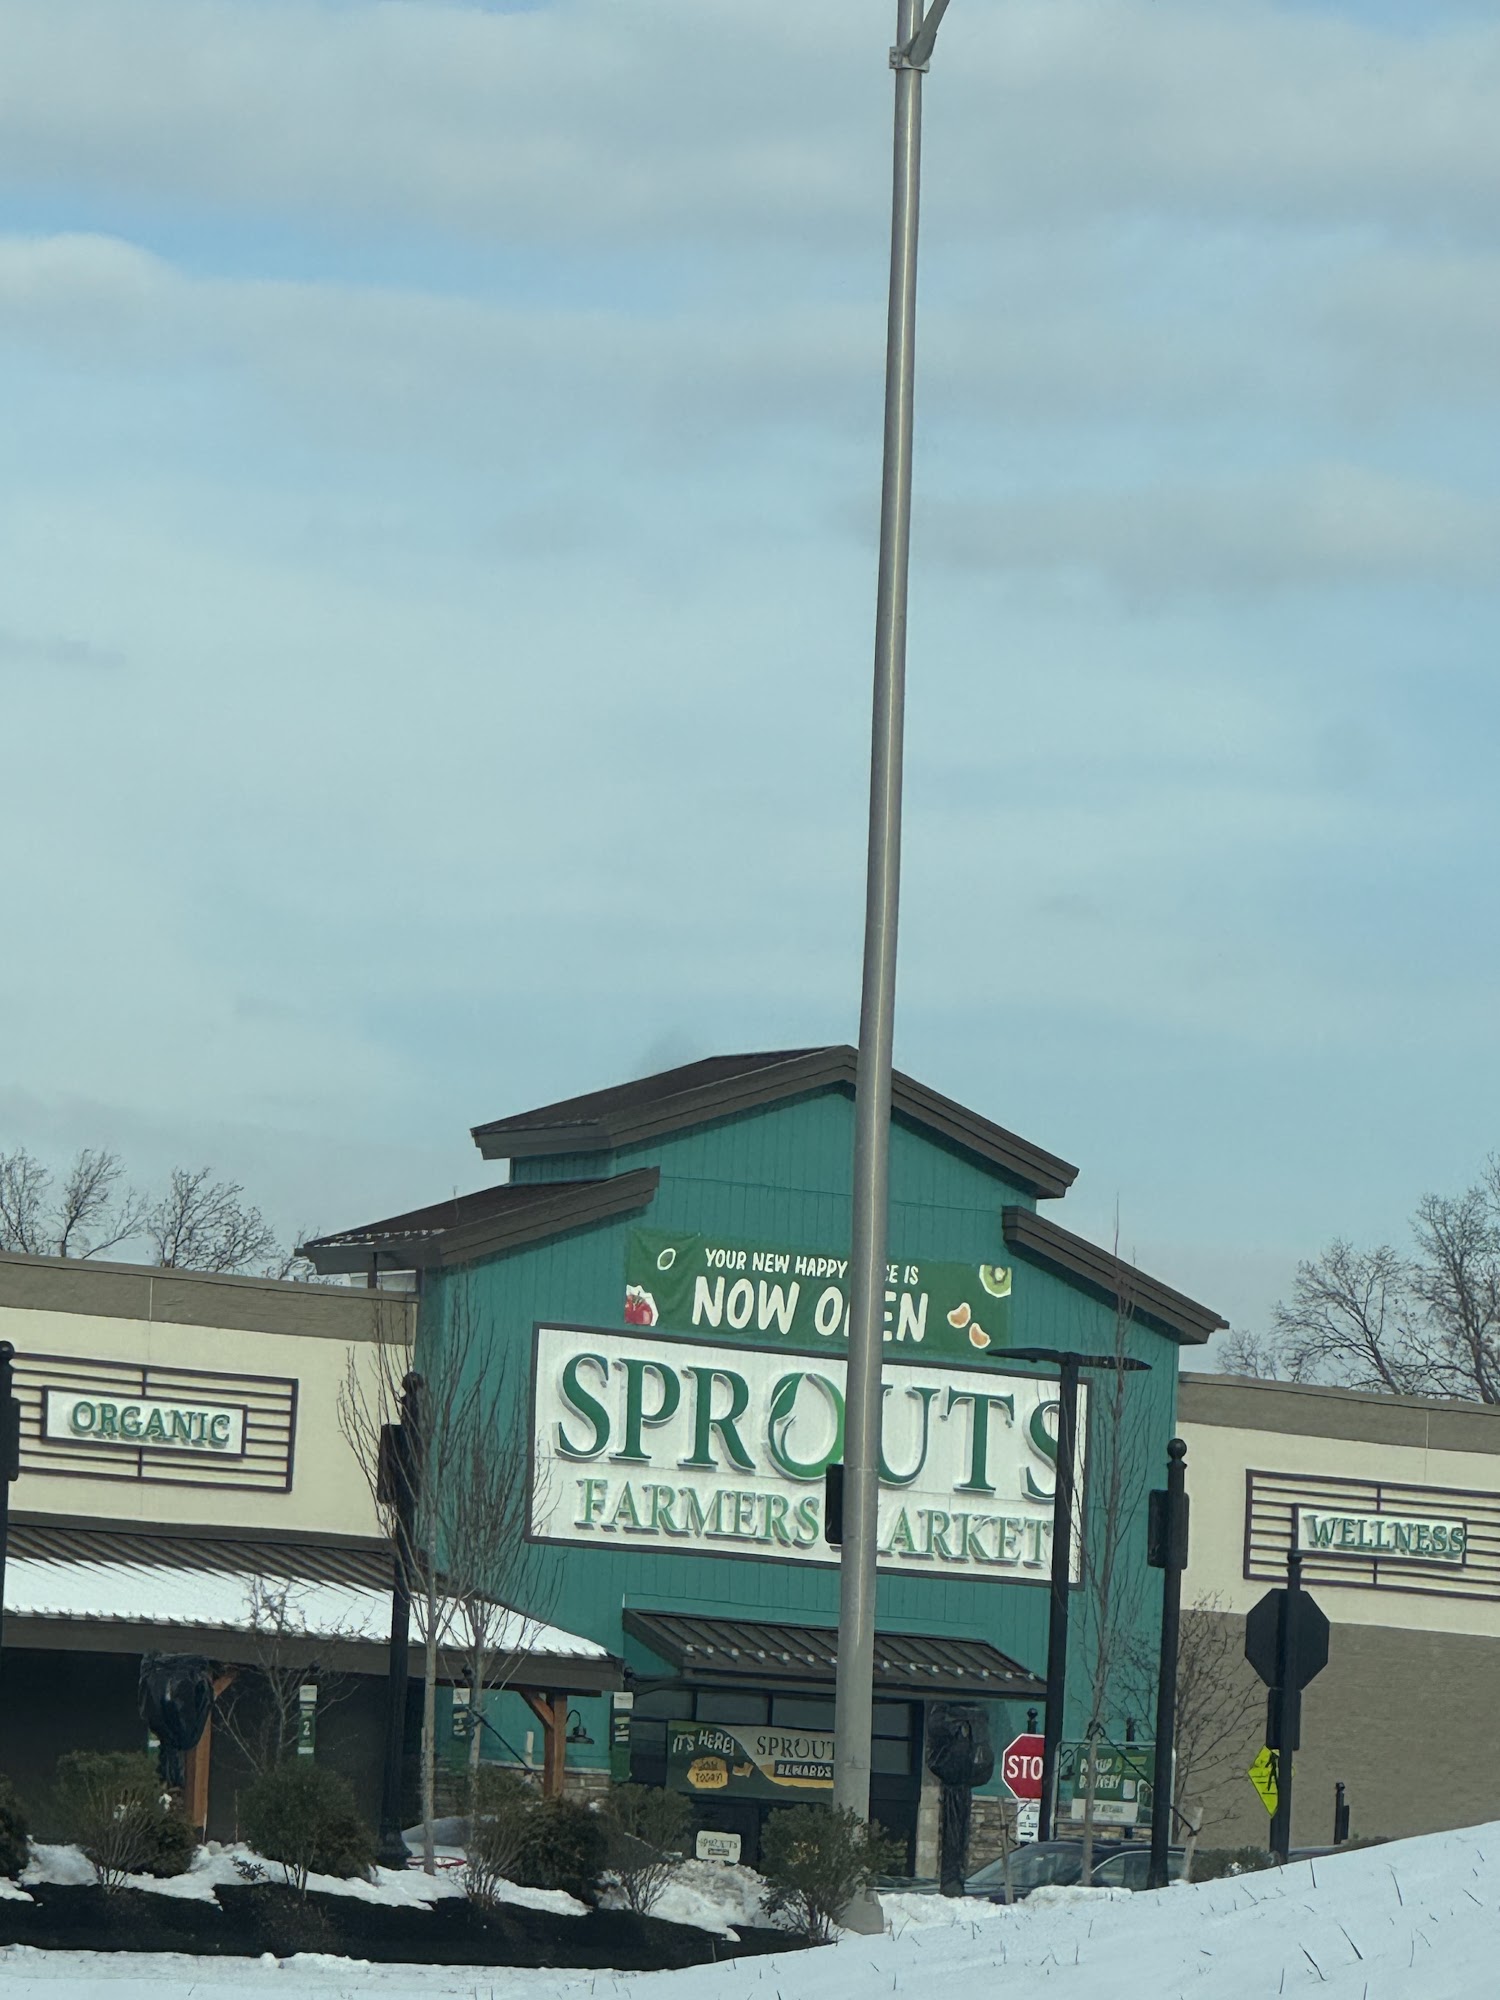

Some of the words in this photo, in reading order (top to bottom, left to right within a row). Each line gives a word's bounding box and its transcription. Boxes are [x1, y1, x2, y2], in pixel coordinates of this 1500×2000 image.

[705, 1248, 747, 1270] YOUR
[752, 1252, 790, 1274] NEW
[795, 1255, 848, 1279] HAPPY
[903, 1264, 919, 1286] IS
[691, 1275, 801, 1336] NOW
[70, 1400, 231, 1445] ORGANIC
[555, 1352, 1060, 1500] SPROUTS
[575, 1477, 821, 1548] FARMERS
[885, 1505, 1054, 1567] ARKET
[1303, 1514, 1465, 1555] WELLNESS
[698, 1729, 735, 1757] HERE!
[1006, 1754, 1044, 1781] STO
